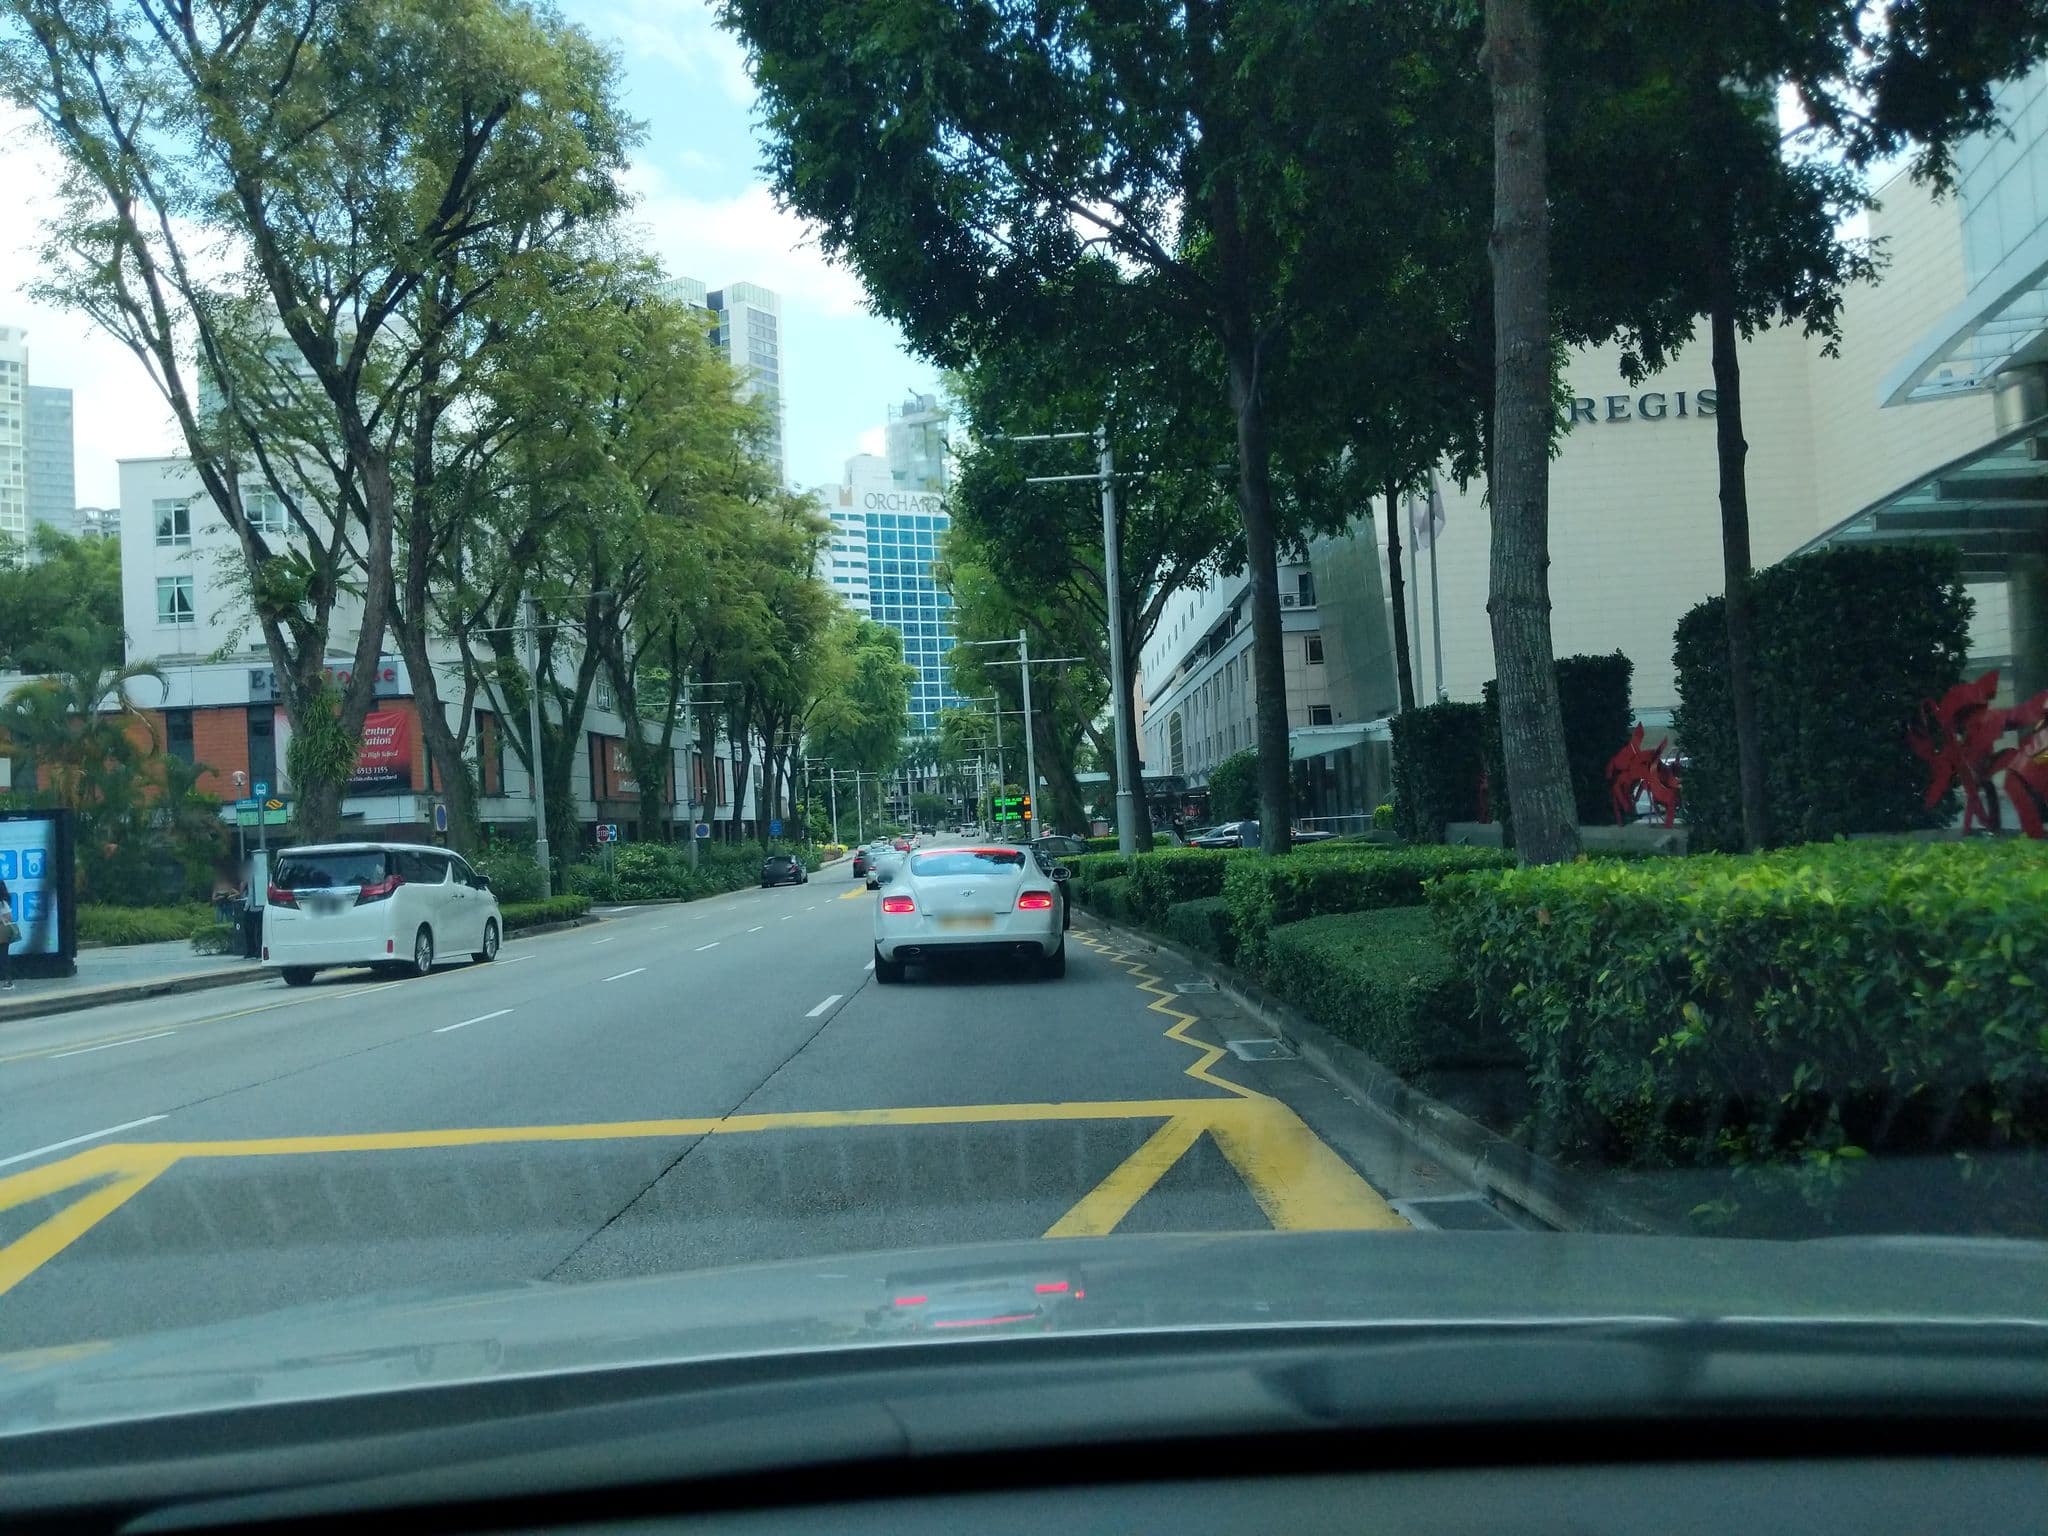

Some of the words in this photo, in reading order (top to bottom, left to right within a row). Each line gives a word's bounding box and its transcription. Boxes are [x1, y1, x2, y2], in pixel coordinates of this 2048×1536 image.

[1569, 388, 1718, 424] REGIS
[864, 492, 941, 513] ORCHARD
[365, 727, 396, 736] entury
[366, 737, 391, 745] ation
